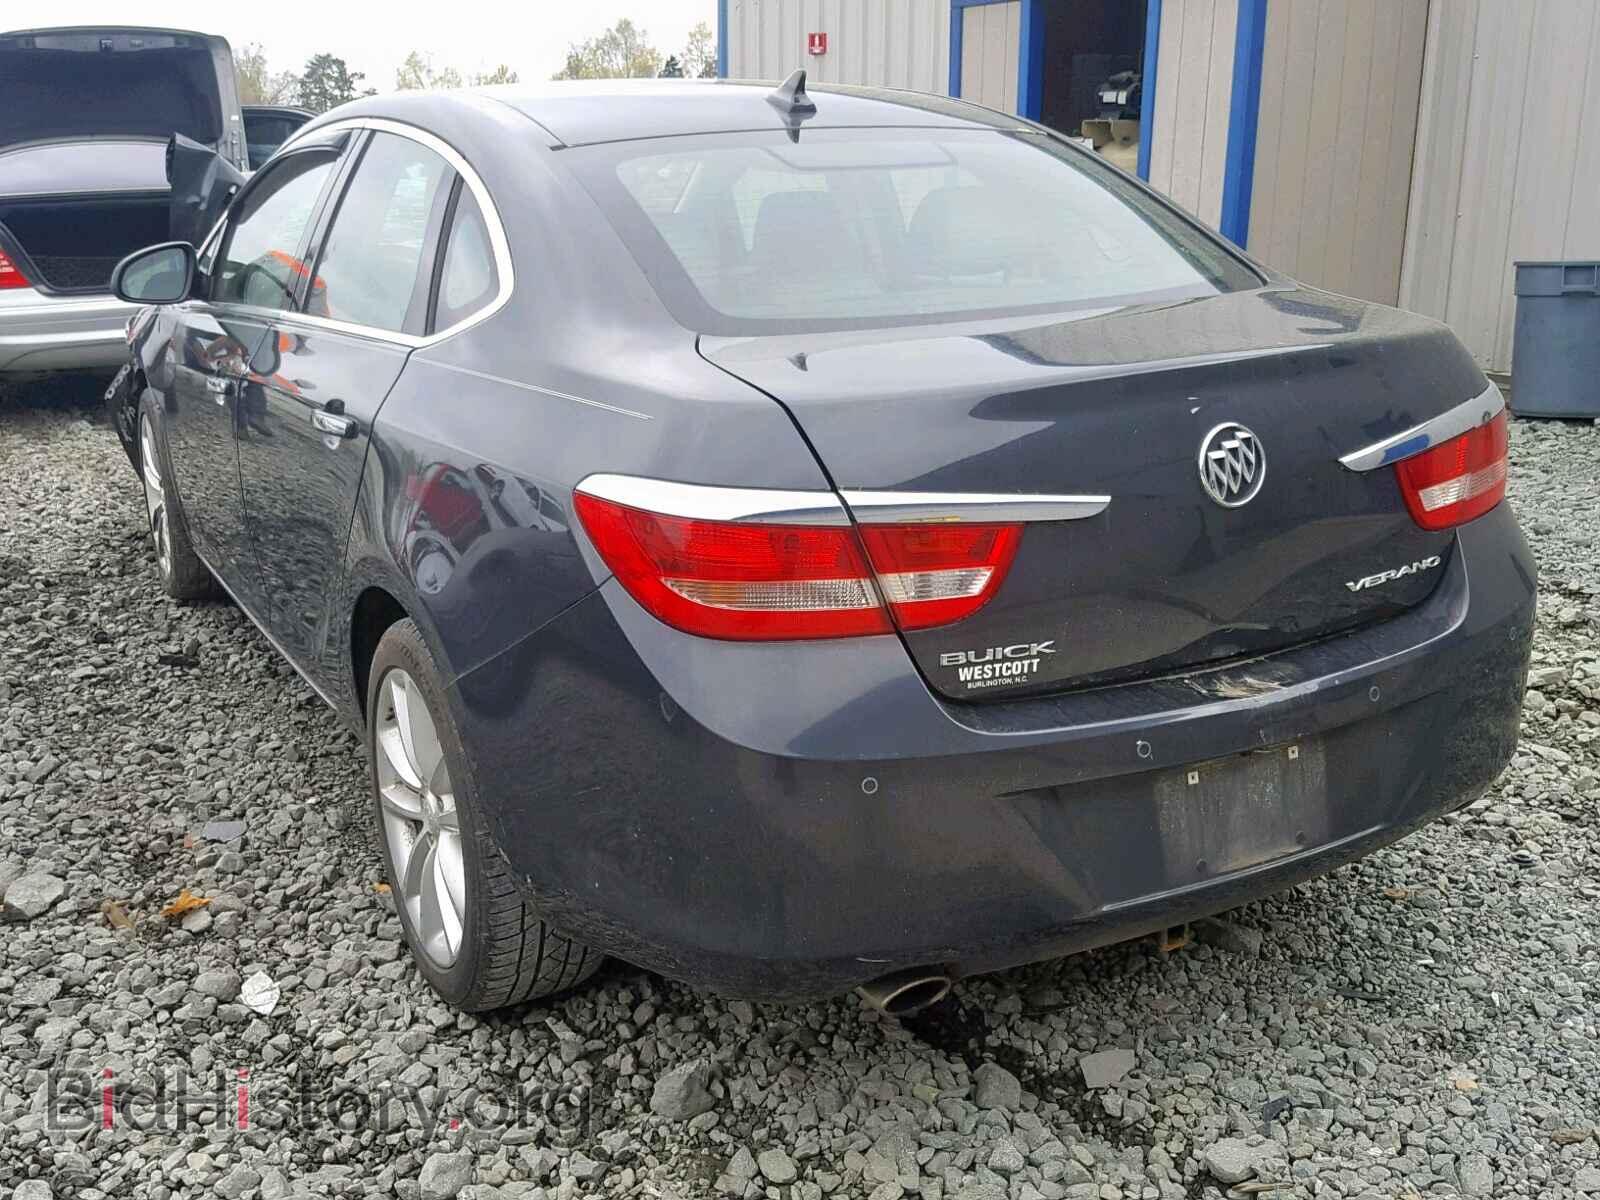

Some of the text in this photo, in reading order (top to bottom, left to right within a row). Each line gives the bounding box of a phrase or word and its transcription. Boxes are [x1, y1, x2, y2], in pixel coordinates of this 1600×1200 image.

[1346, 555, 1441, 592] VERANO
[939, 640, 1056, 666] BUICK
[958, 658, 1040, 681] WESTCOTT
